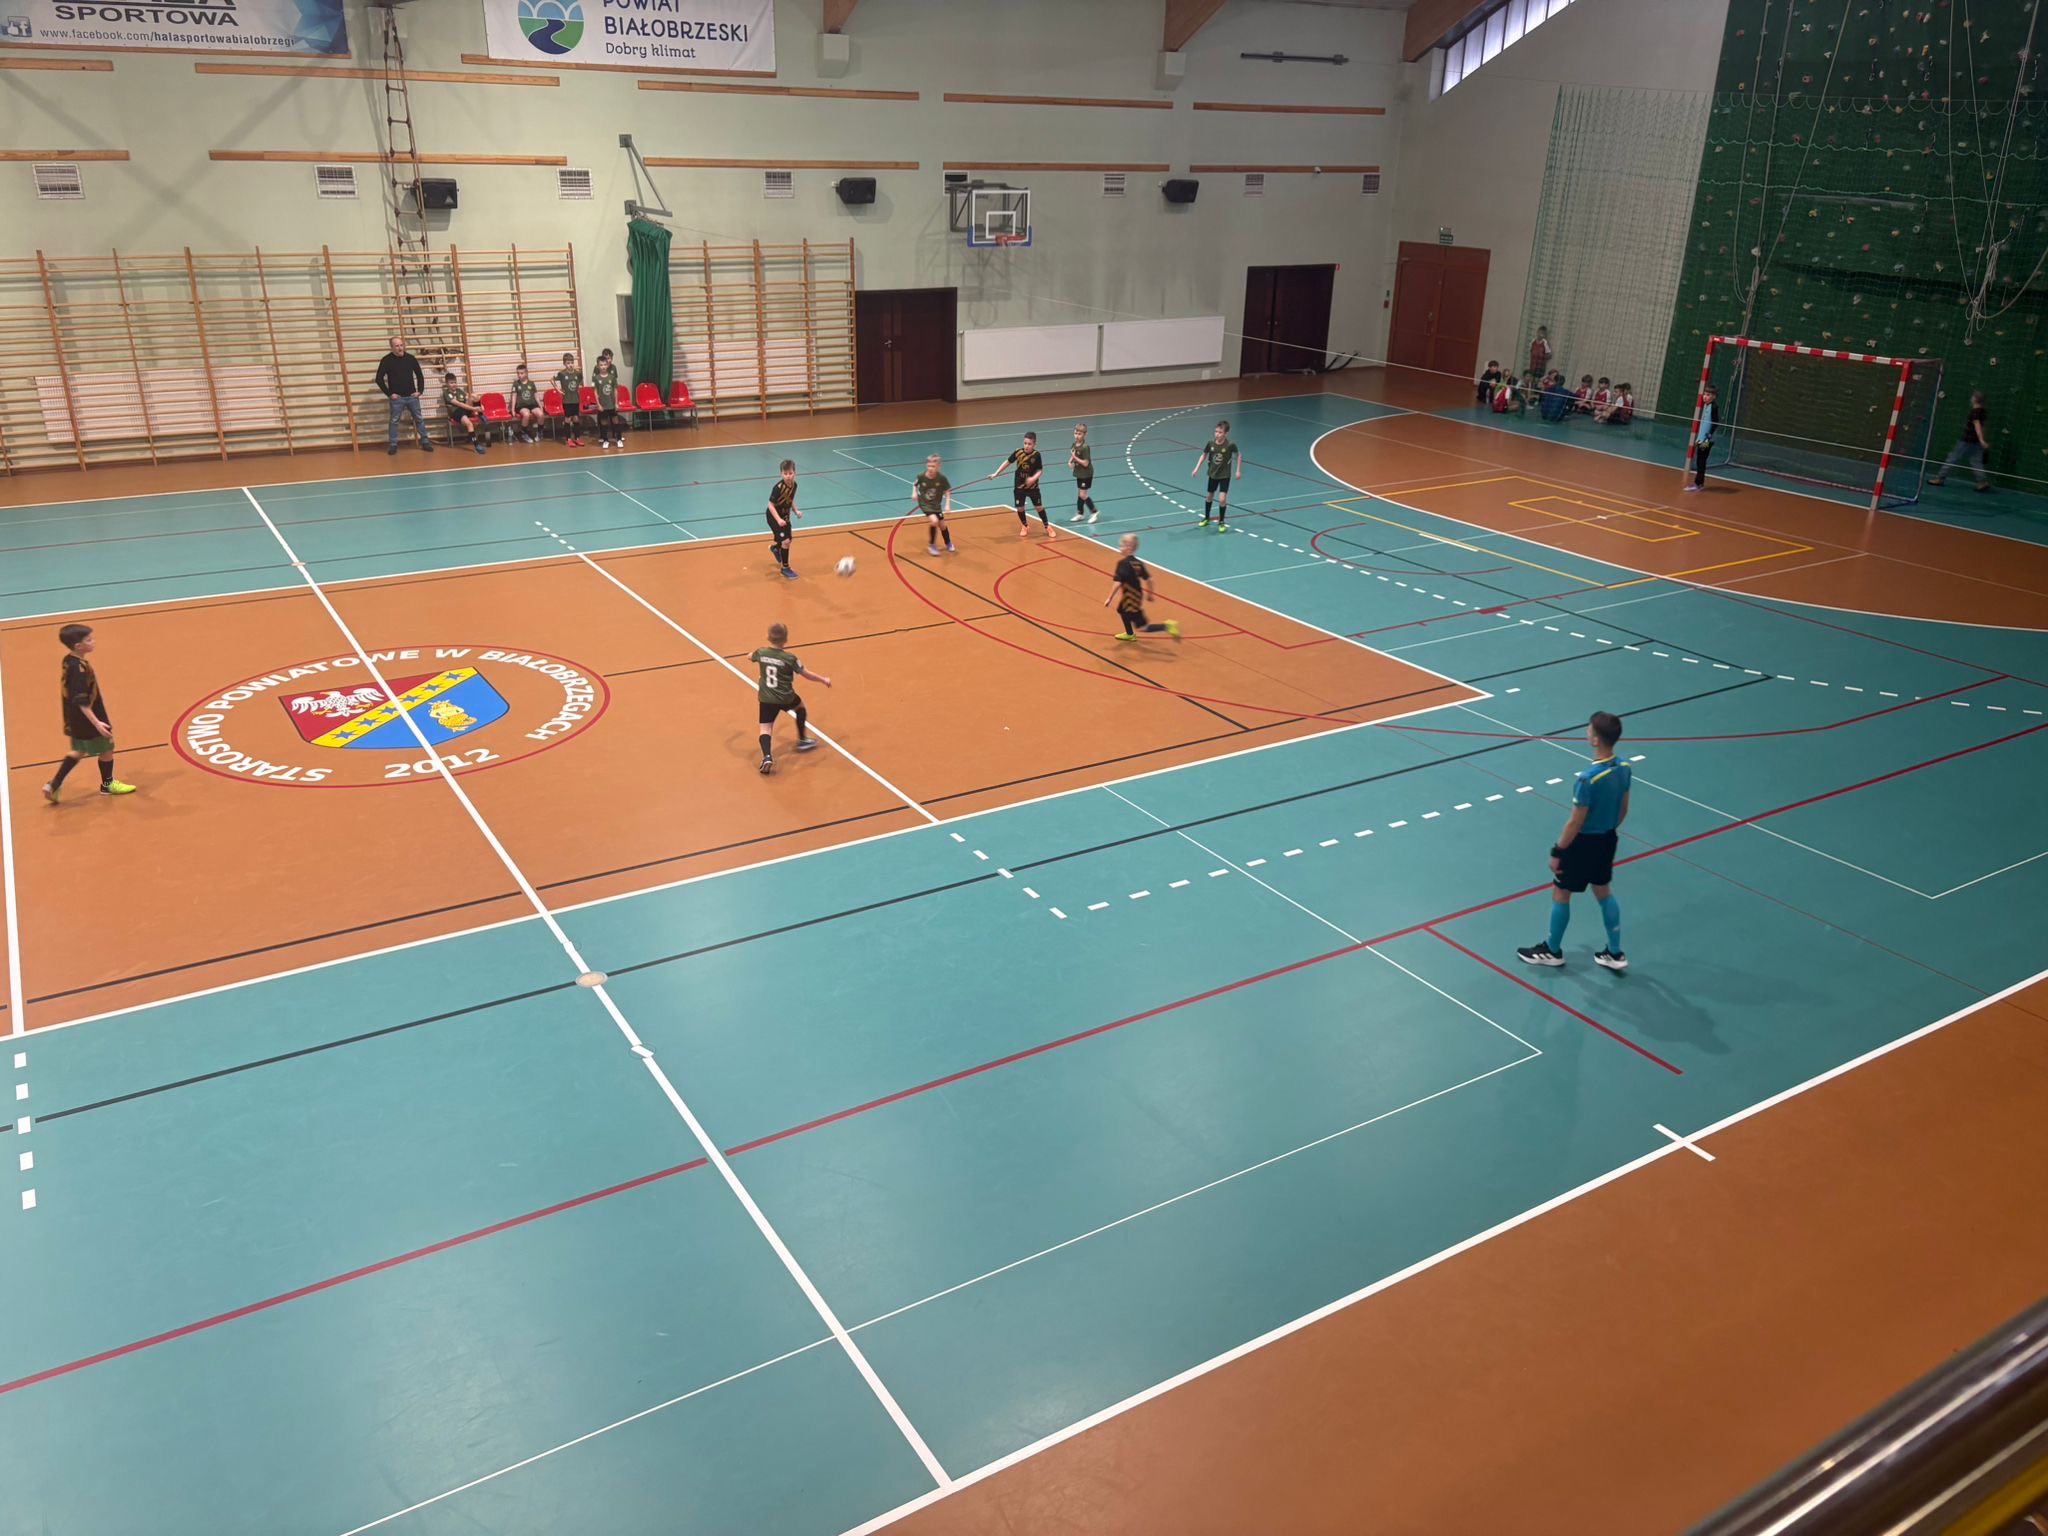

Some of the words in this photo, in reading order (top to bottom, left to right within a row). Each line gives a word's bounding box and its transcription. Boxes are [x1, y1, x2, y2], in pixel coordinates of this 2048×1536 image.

[55, 5, 239, 27] SPORTOWA
[604, 15, 748, 42] BIAŁOBRZESKI
[605, 42, 647, 58] Dobry
[651, 43, 696, 58] klimat
[434, 648, 471, 658] W
[204, 648, 420, 710] POWIATOWE
[765, 665, 778, 688] 8
[187, 713, 333, 782] STAROSTWO
[384, 748, 500, 778] 2012
